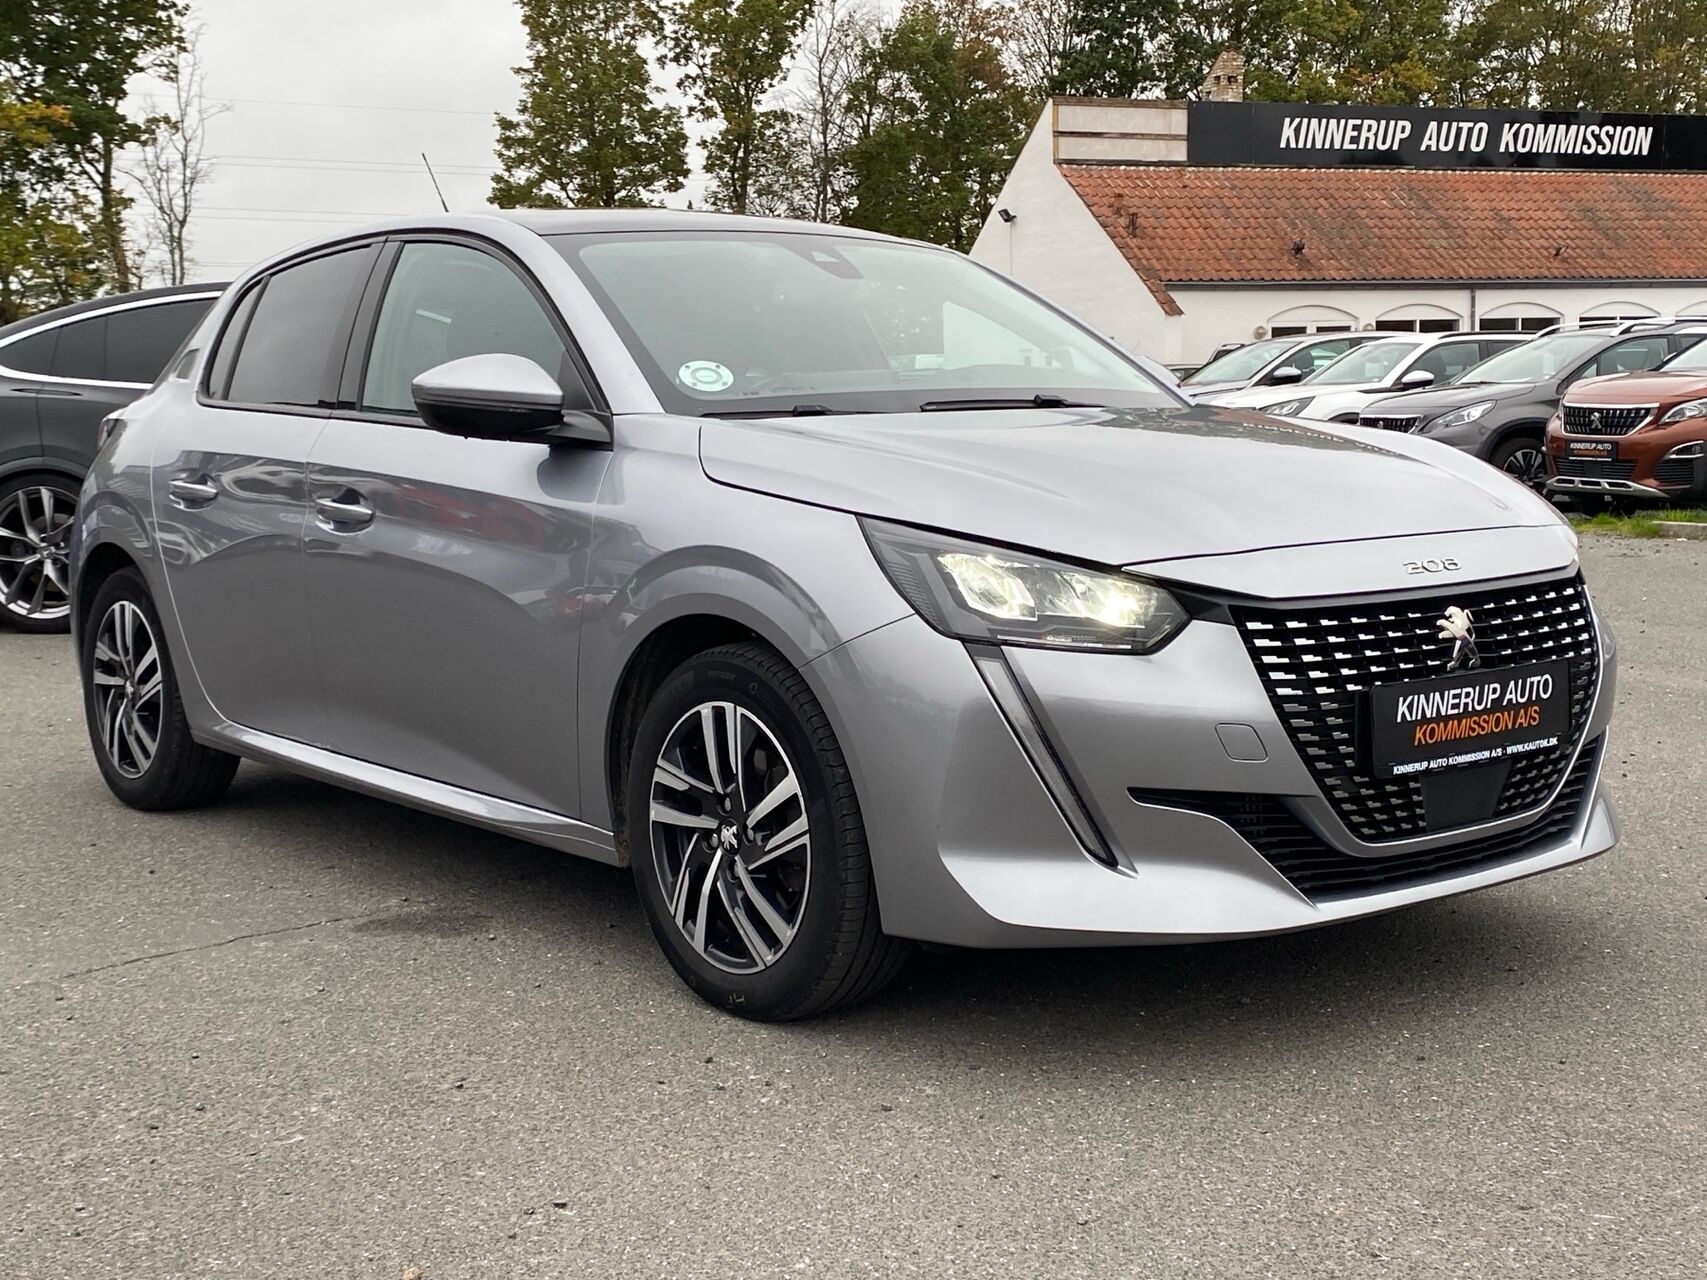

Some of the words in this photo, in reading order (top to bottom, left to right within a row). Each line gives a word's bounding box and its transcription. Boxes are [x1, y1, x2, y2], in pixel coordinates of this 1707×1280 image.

[1279, 117, 1412, 150] KINNERUP
[1420, 121, 1488, 153] AUTO
[1499, 122, 1653, 156] KOMMISSION
[1403, 558, 1462, 574] 208
[1396, 683, 1501, 723] KINNERUP
[1502, 673, 1553, 705] AUTO
[1414, 713, 1514, 746] KOMMISSION
[1516, 706, 1540, 727] A/S
[1393, 761, 1429, 775] KINNERUP
[1429, 758, 1448, 769] AUTO
[1448, 749, 1490, 765] KOMMISSION
[1491, 748, 1502, 758] A/S
